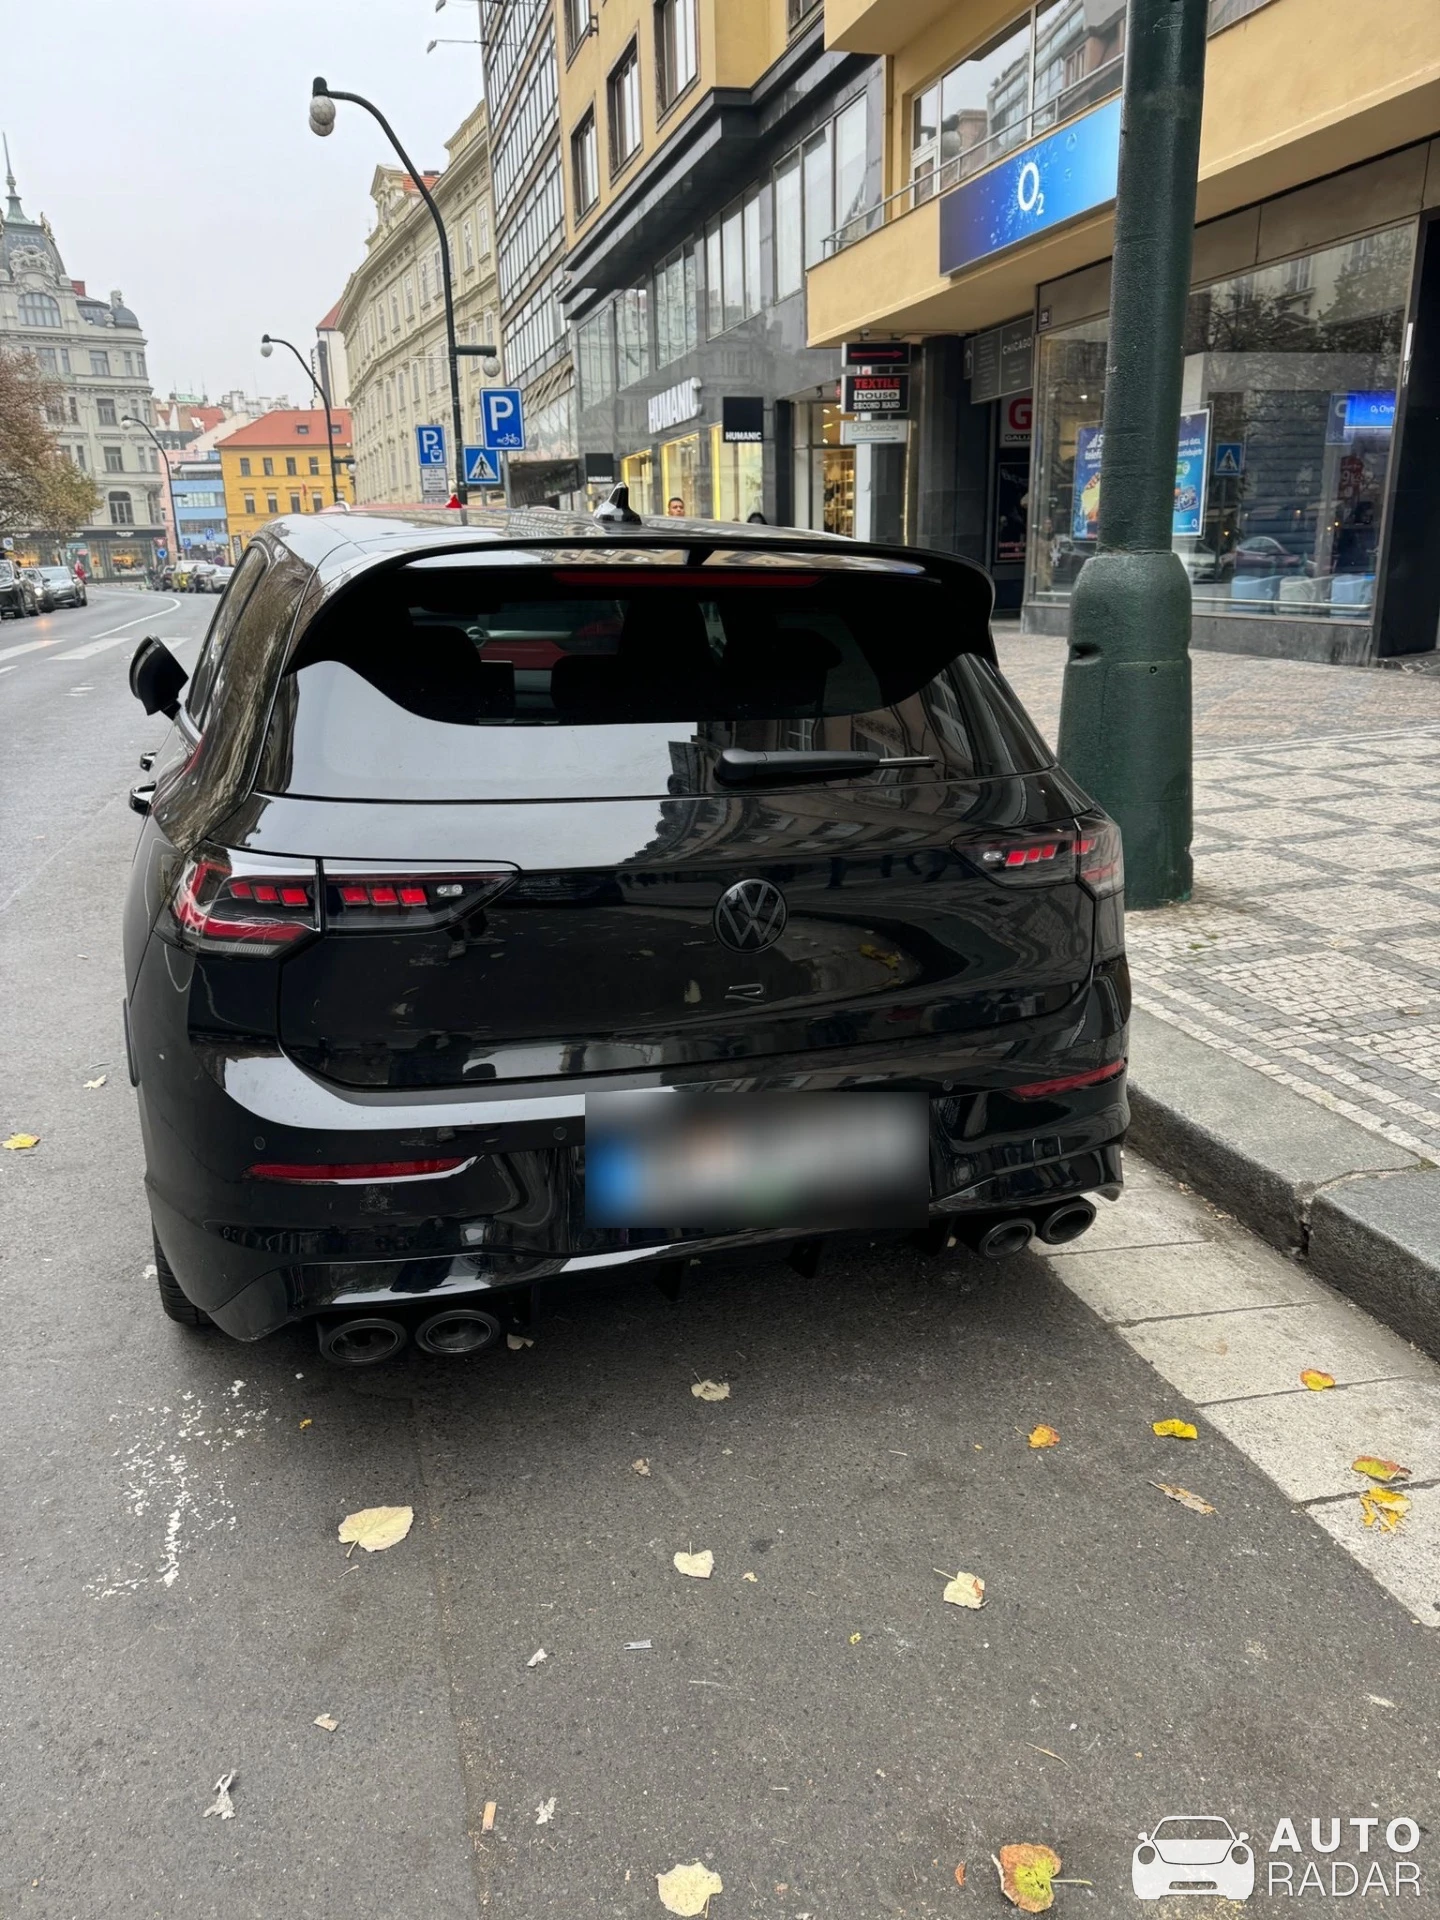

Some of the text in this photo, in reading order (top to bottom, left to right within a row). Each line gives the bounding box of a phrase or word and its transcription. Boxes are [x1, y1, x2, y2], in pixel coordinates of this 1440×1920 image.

[854, 378, 900, 389] TEXTILE
[856, 391, 898, 399] house
[648, 377, 702, 435] HUMANIC
[853, 400, 901, 410] SECOND HAND
[489, 396, 514, 432] P
[725, 431, 762, 441] HUMANIC
[422, 430, 439, 454] P
